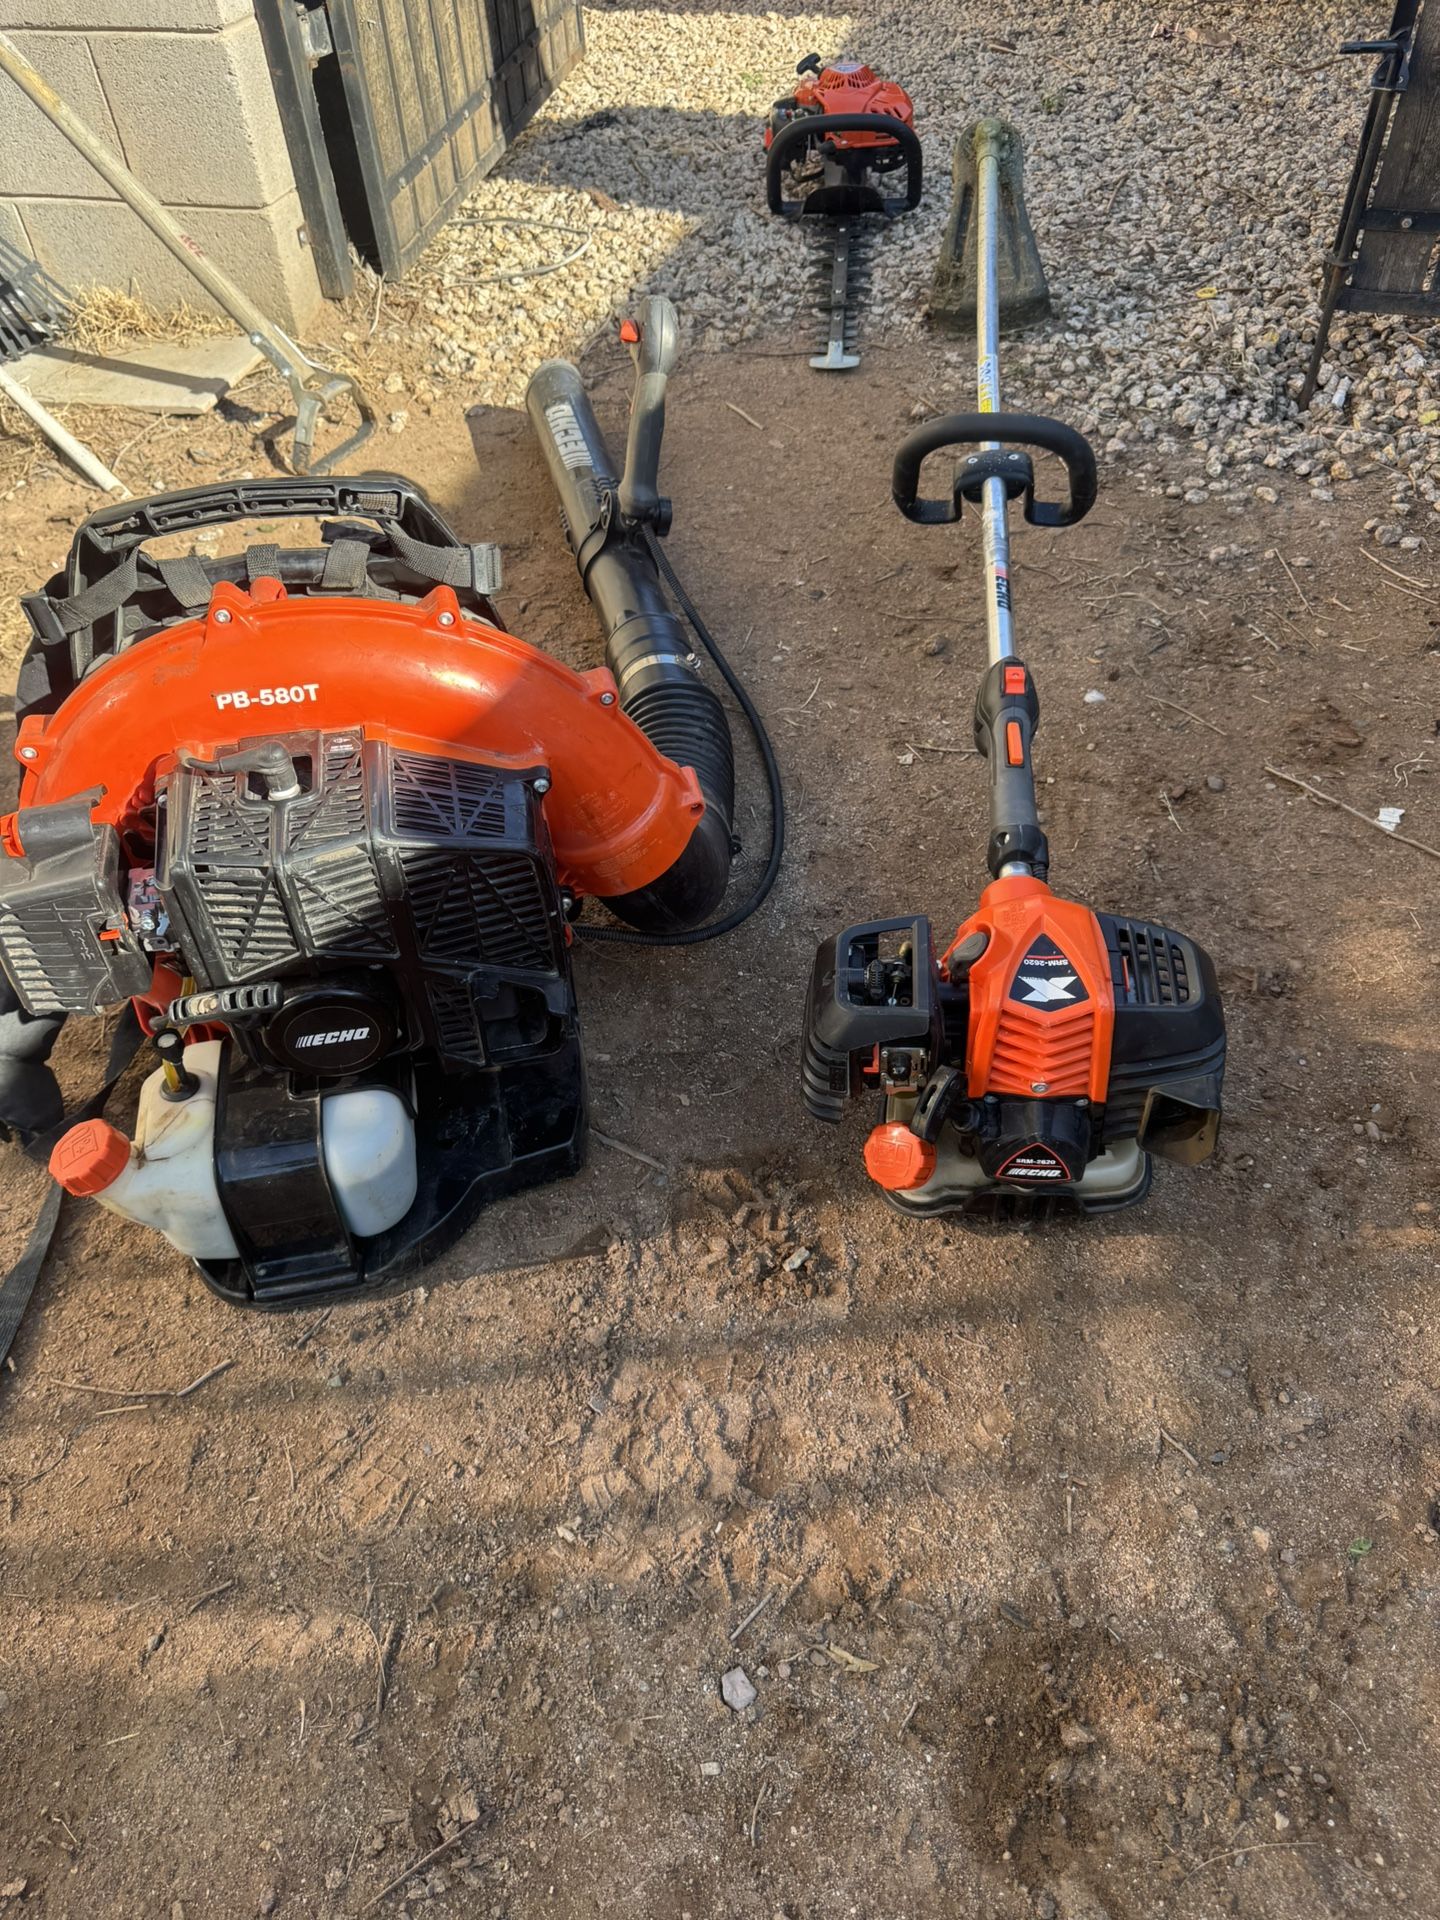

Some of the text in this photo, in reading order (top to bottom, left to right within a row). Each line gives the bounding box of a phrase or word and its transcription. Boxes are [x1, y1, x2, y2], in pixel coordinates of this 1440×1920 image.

[546, 404, 590, 458] ECHO
[216, 684, 320, 710] PB-580T
[1023, 958, 1069, 967] SRM-2620
[311, 1027, 370, 1046] ECHO
[1019, 1168, 1062, 1177] ECHO
